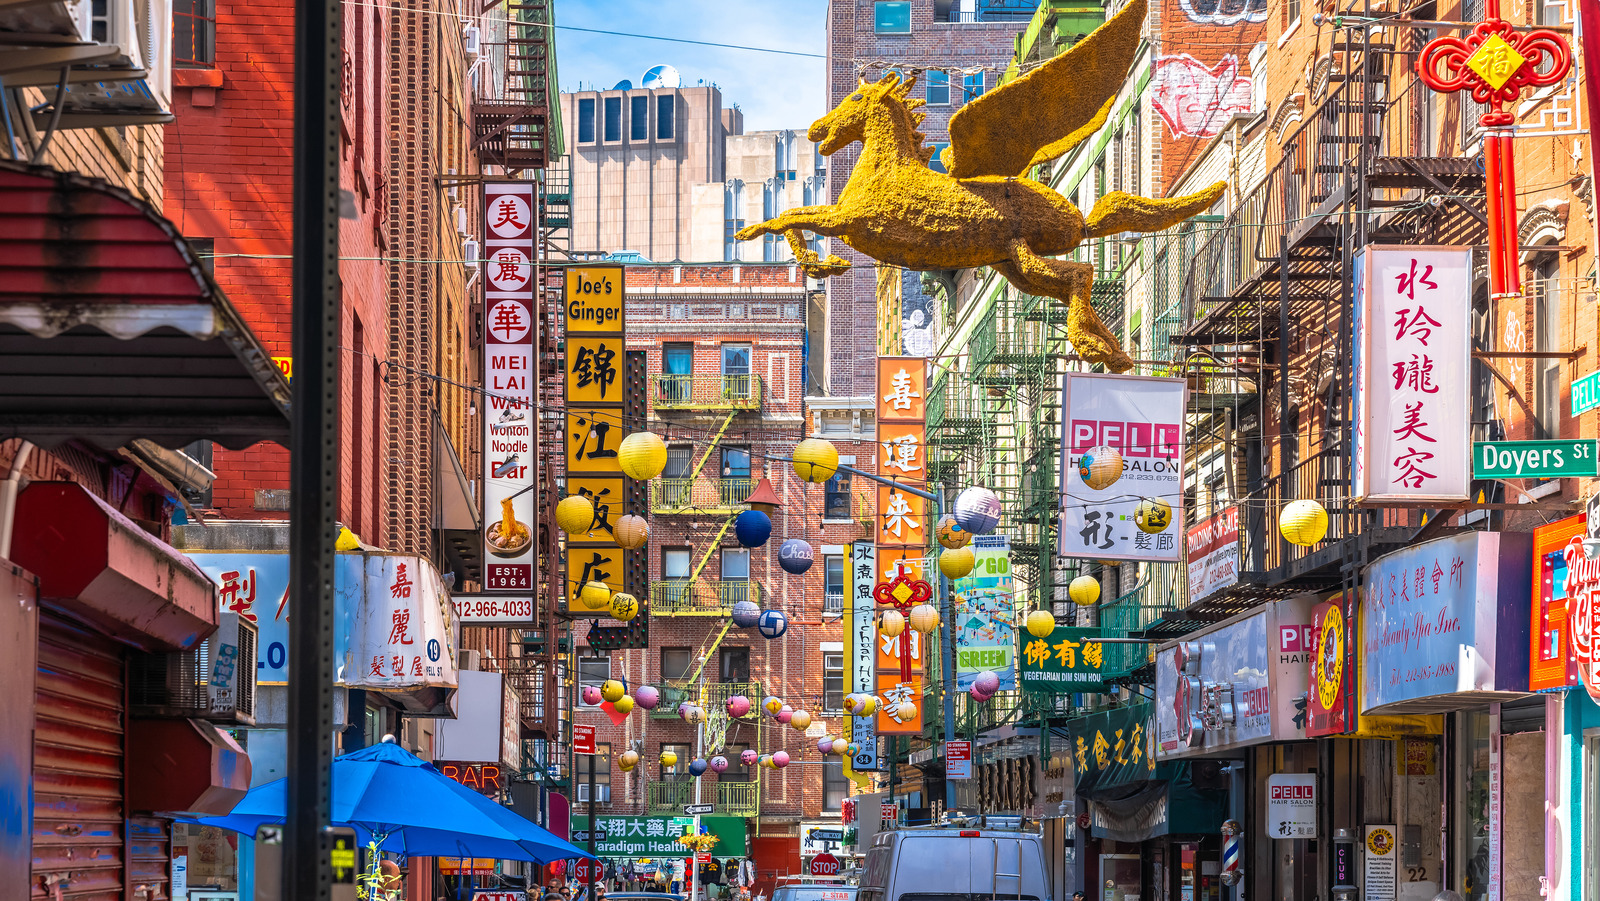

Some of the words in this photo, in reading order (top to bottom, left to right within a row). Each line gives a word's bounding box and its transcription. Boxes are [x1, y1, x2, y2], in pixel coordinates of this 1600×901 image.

[1478, 45, 1511, 80] 福
[493, 200, 527, 340] 美麗華
[576, 275, 612, 295] Joe's
[569, 301, 620, 324] Ginger
[492, 356, 526, 370] MEI
[1392, 258, 1442, 489] 水玲瓏美容
[494, 376, 526, 390] LAI
[490, 396, 530, 410] WAH
[1572, 378, 1598, 412] PELL
[490, 424, 529, 436] Wonton
[1074, 424, 1174, 454] PELL
[492, 440, 528, 452] Noodle
[1122, 460, 1179, 473] SALON
[1483, 444, 1564, 475] Doyers
[1572, 443, 1590, 459] St
[491, 461, 528, 479] Bar
[1224, 512, 1238, 536] SALE
[496, 567, 522, 576] EST:
[856, 546, 874, 599] 水煮魚
[986, 558, 1008, 574] GO
[490, 578, 527, 586] 1964
[388, 562, 414, 645] 嘉麗
[453, 602, 532, 618] 12-966-4033
[1434, 606, 1460, 634] Inc.
[428, 640, 438, 661] 19
[959, 650, 1006, 668] GREEN
[1023, 638, 1103, 670] 佛有緣
[368, 656, 424, 678] 髮型屋
[1024, 671, 1060, 682] VEGETARIAN
[1062, 672, 1072, 682] DIM
[1074, 673, 1087, 682] SUM
[1244, 687, 1268, 717] PELL
[1074, 722, 1144, 774] 素食之家
[858, 756, 870, 764] 34
[443, 766, 500, 788] BAR
[1272, 786, 1312, 798] PELL
[649, 841, 687, 852] Health
[576, 865, 602, 877] STP
[812, 861, 838, 874] STOP
[1408, 867, 1427, 882] 22
